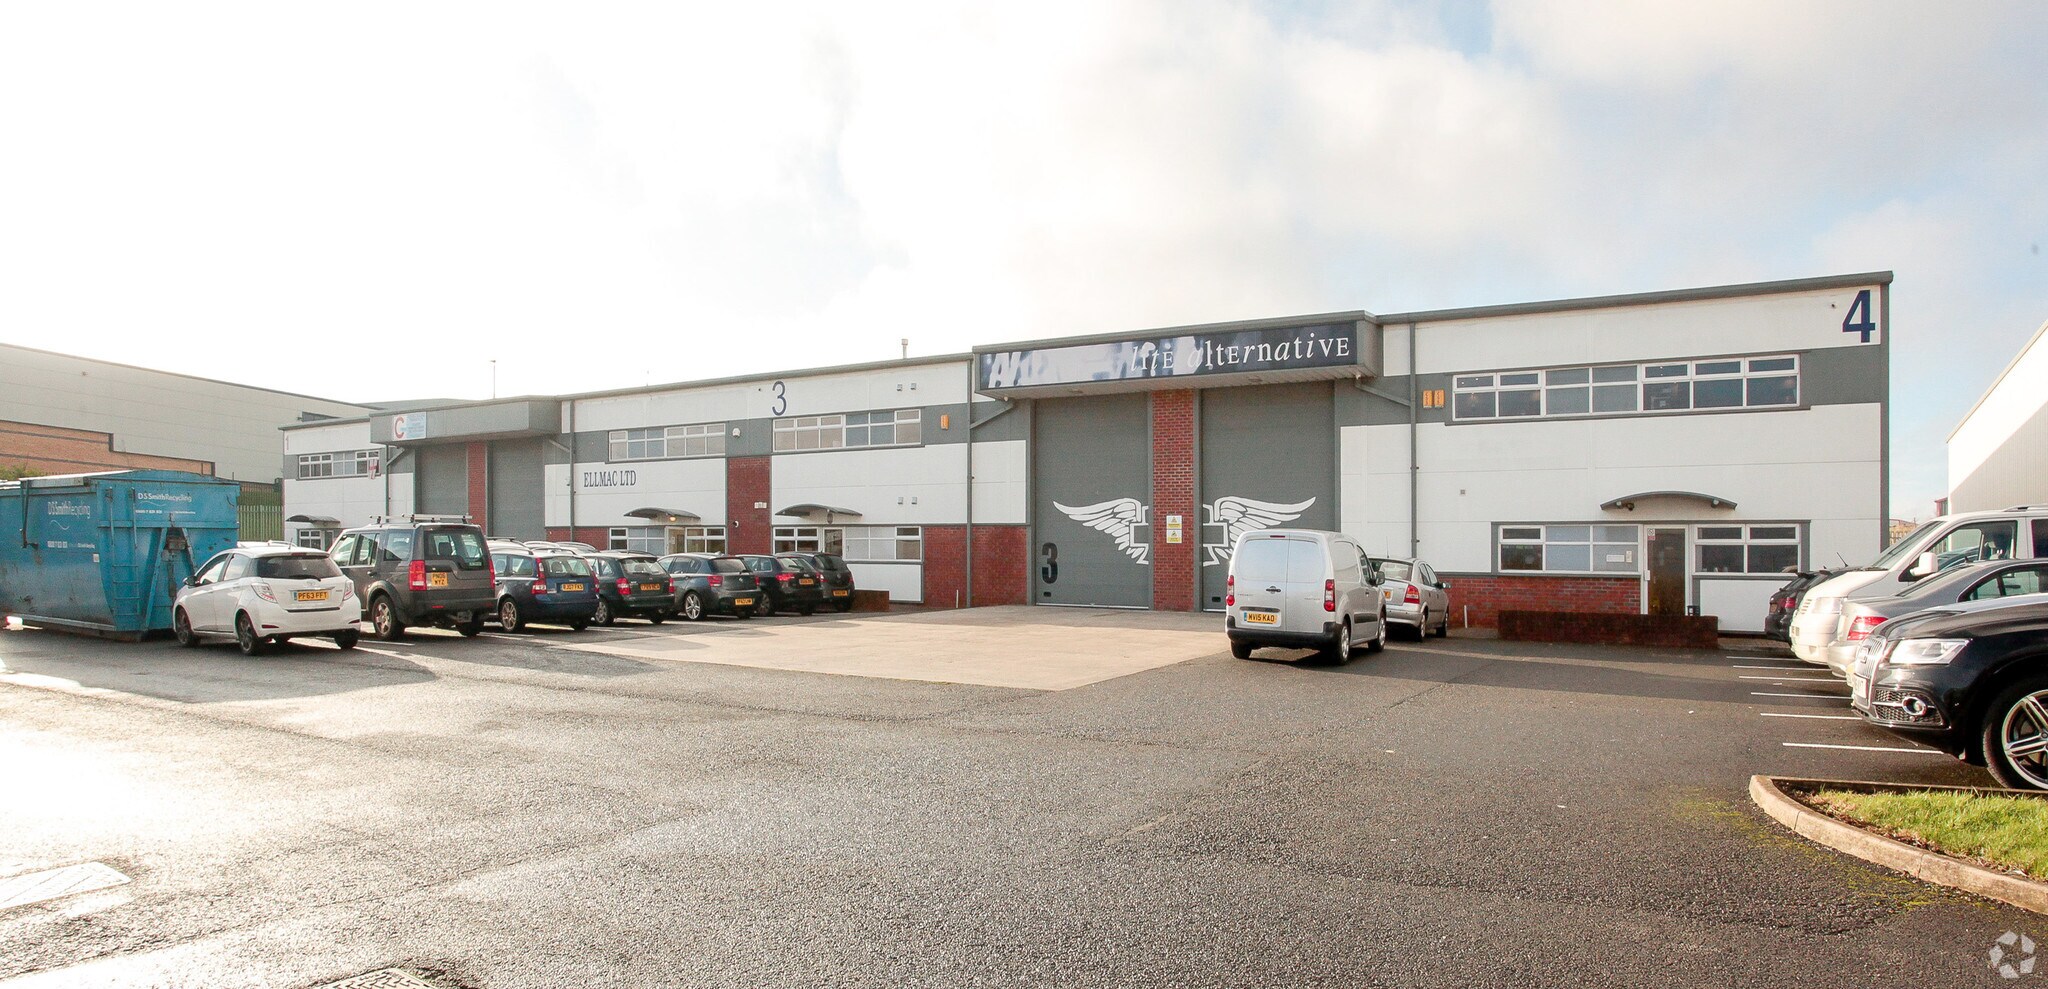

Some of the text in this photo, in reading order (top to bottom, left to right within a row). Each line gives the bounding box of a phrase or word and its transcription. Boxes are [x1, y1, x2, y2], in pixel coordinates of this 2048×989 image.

[1842, 290, 1876, 343] 4
[772, 380, 787, 416] 3
[583, 470, 637, 488] ELLMAC LTD
[1041, 542, 1058, 584] 3
